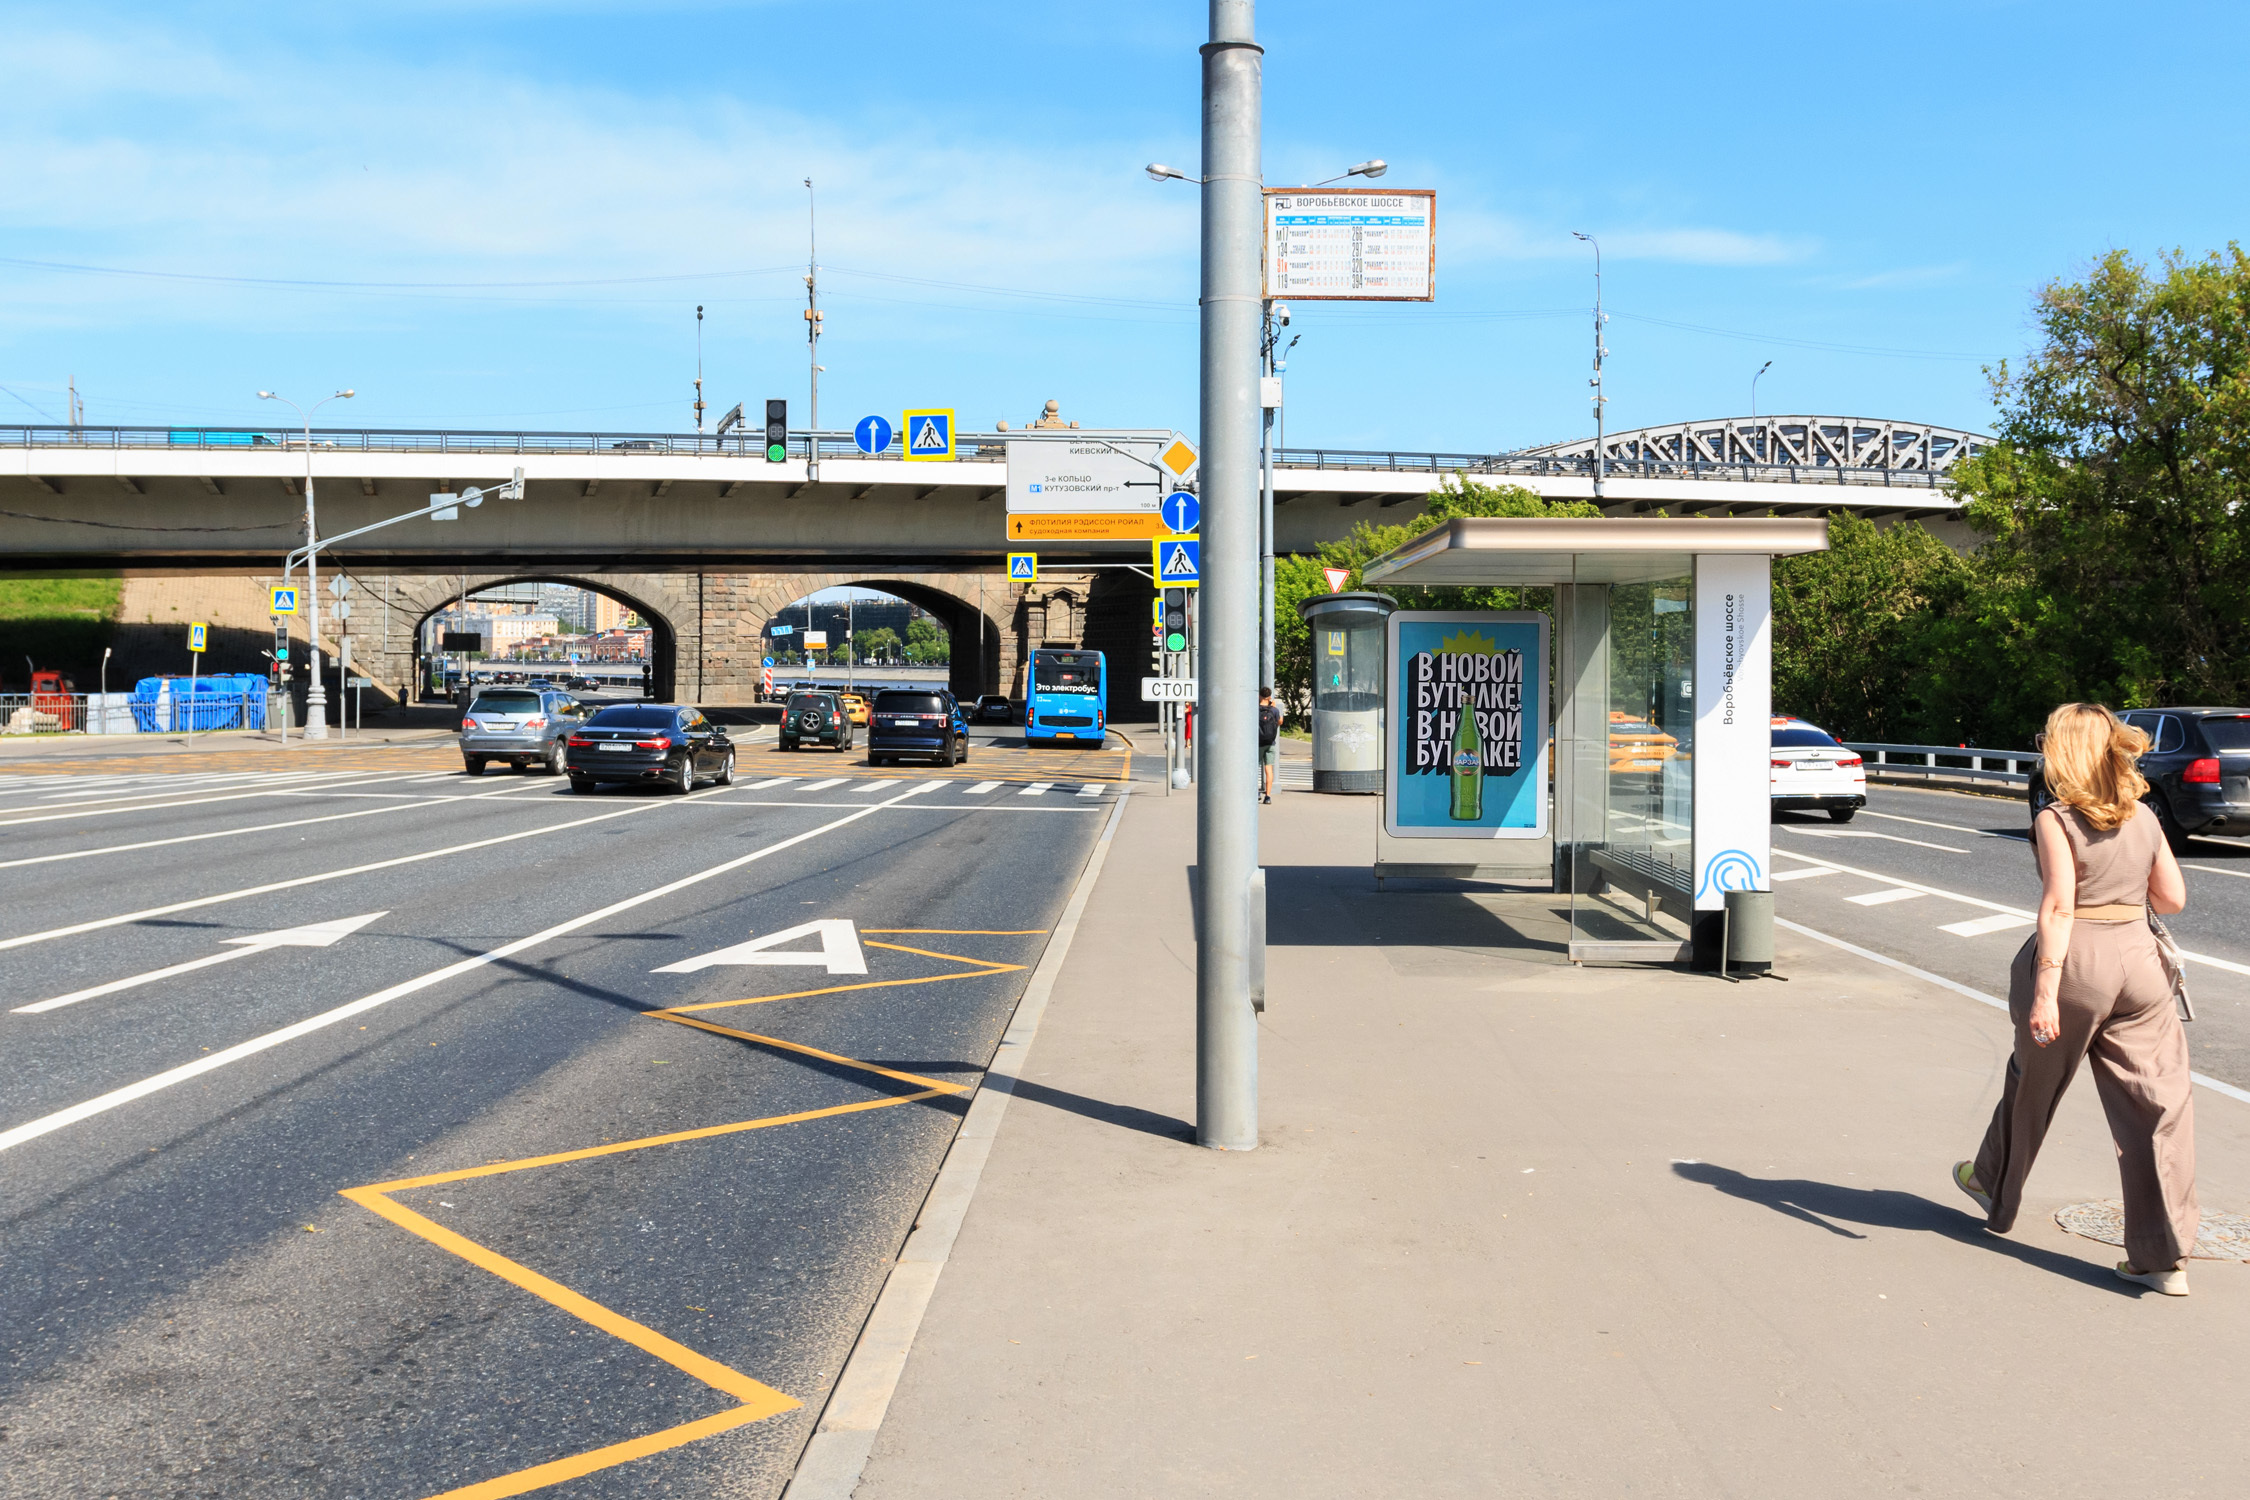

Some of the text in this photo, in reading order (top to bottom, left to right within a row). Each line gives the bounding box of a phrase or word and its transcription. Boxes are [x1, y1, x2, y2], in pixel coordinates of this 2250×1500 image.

[1296, 196, 1404, 208] ВОРОБЬЁВСКОЕ ШОССЕ
[1069, 446, 1112, 455] КИЕВСКИЙ
[1058, 475, 1092, 483] КОЛЬЦО
[1044, 484, 1102, 492] КУТУЗОВСКИЙ
[1029, 518, 1072, 526] ФЛОТИЛИЯ
[1073, 518, 1116, 526] РЭДИССОН
[1736, 593, 1745, 623] Shosse
[1723, 593, 1736, 725] Воробьёвское шоссе
[1418, 648, 1523, 683] В НОВОЙ
[1035, 682, 1098, 694] Это электробус.
[1151, 682, 1193, 697] СТОП
[1417, 706, 1522, 741] В НВОЙ
